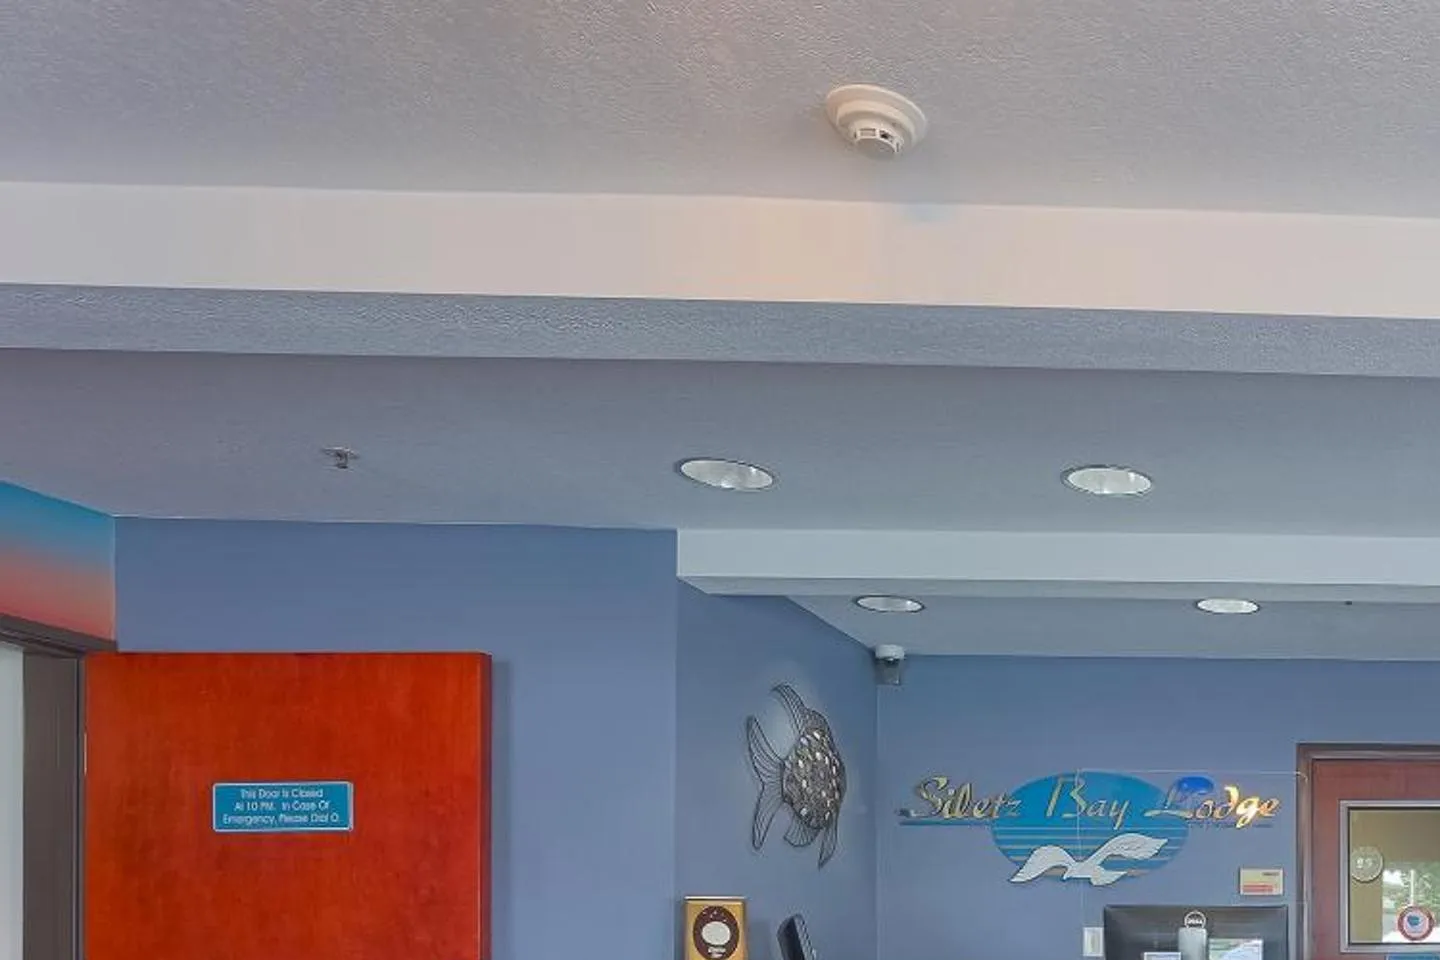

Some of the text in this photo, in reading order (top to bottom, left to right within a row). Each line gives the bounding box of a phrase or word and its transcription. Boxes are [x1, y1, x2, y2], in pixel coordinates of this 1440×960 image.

[241, 789, 257, 799] This
[259, 789, 280, 799] Door
[291, 788, 323, 798] Closed
[247, 801, 258, 811] 10
[292, 800, 317, 811] Case
[903, 775, 1280, 830] Siletz Bay Lodge
[280, 814, 308, 823] Please
[311, 813, 329, 822] Dial
